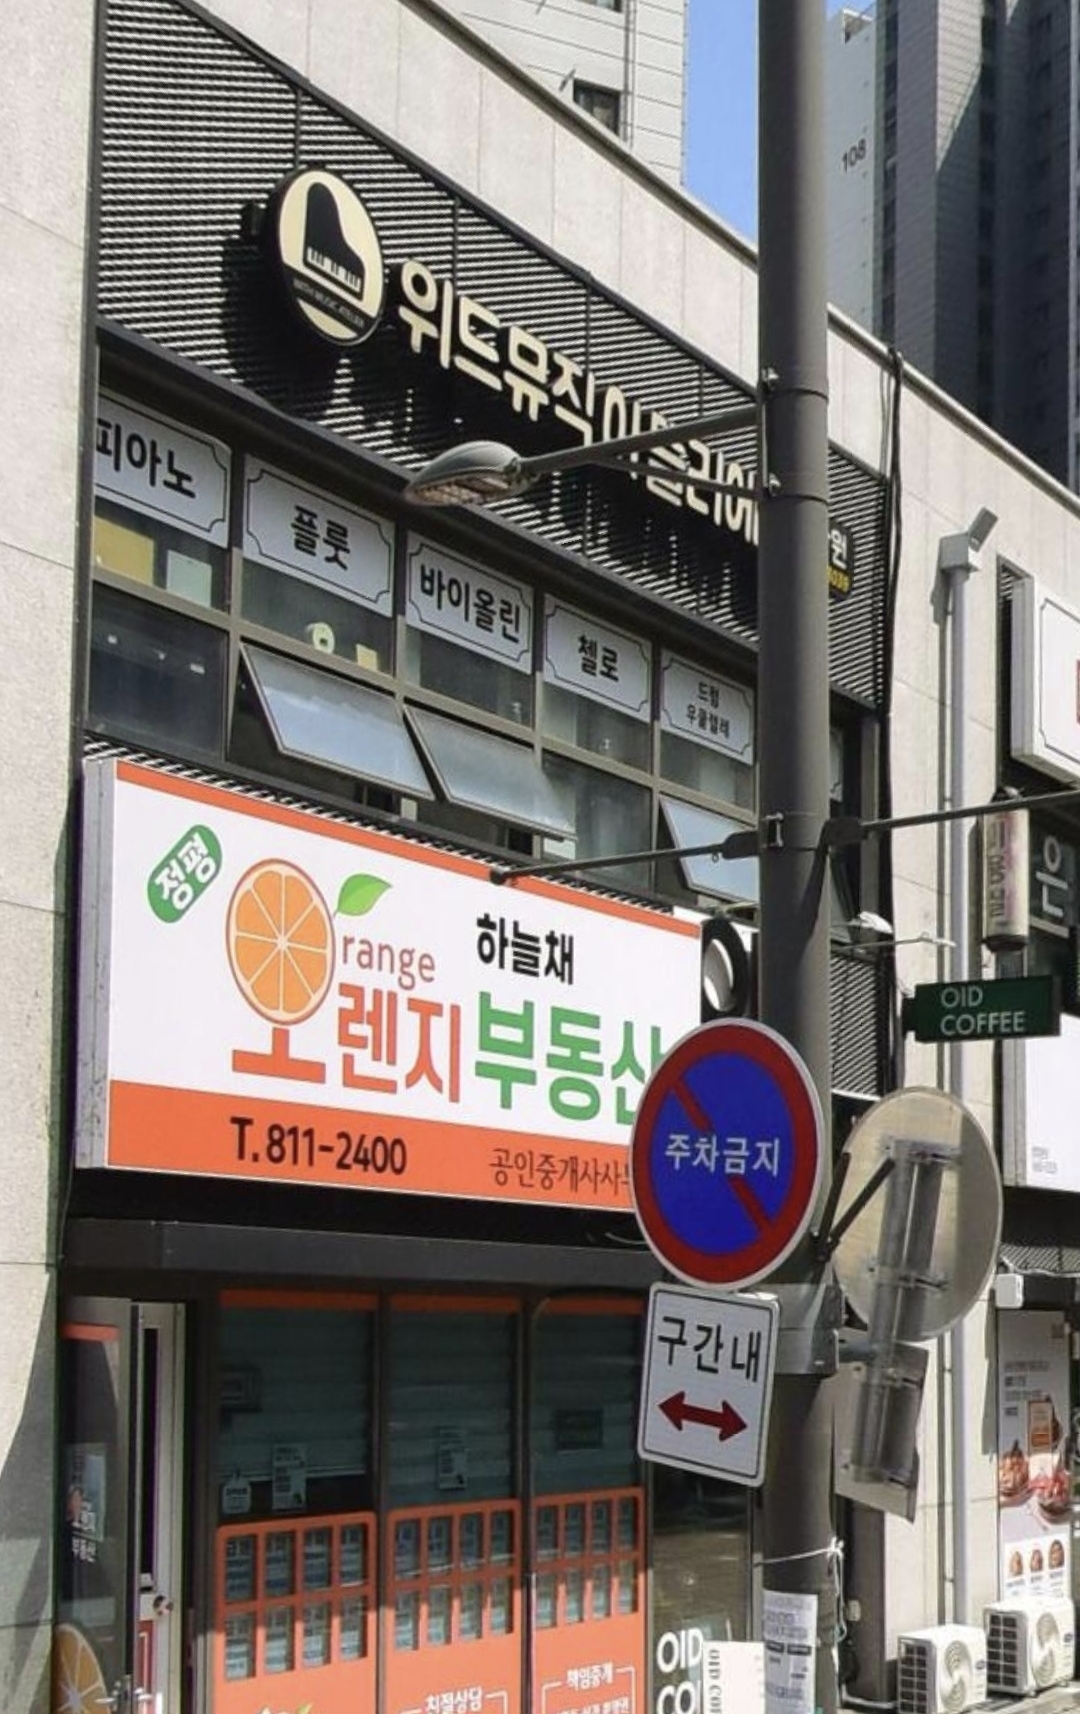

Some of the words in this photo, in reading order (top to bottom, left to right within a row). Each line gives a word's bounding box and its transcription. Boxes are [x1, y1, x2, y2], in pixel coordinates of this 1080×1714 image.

[96, 418, 197, 499] 피아노
[290, 504, 351, 571] 플룻
[420, 564, 520, 644] 바이올린
[577, 634, 620, 683] 첼로
[154, 832, 217, 911] 정평
[476, 912, 574, 985] 하늘채
[940, 985, 983, 1009] OID
[940, 1011, 1026, 1035] COFFEE
[475, 991, 662, 1126] 부동산
[665, 1133, 780, 1178] 주차금지
[656, 1626, 704, 1674] OID
[656, 1680, 702, 1714] CO
